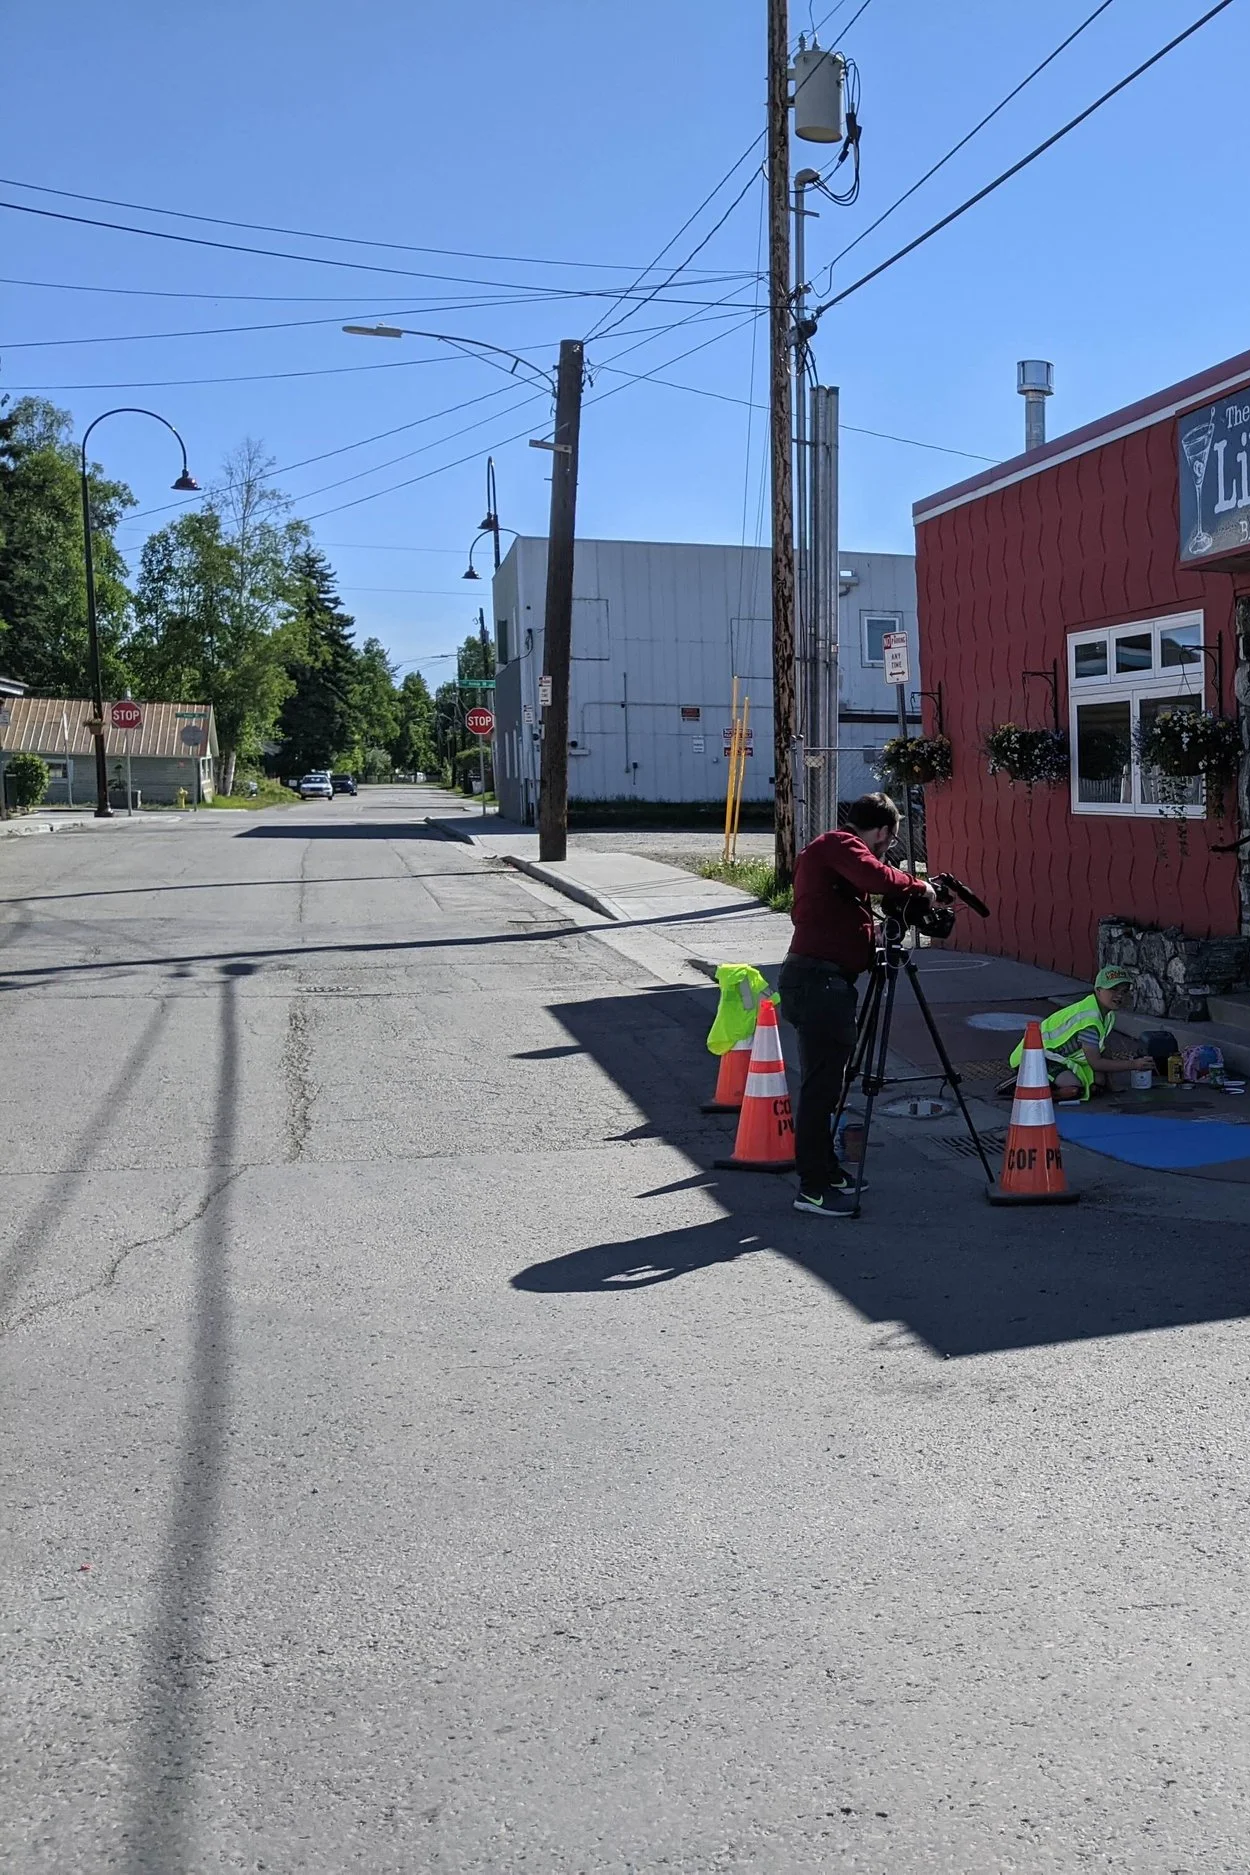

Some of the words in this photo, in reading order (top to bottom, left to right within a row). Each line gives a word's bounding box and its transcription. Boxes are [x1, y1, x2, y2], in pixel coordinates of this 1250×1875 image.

[1226, 405, 1250, 429] The
[891, 661, 902, 669] TIME
[112, 709, 140, 721] STOP
[467, 716, 492, 727] STOP
[773, 1099, 792, 1116] CO
[1007, 1148, 1037, 1170] COF
